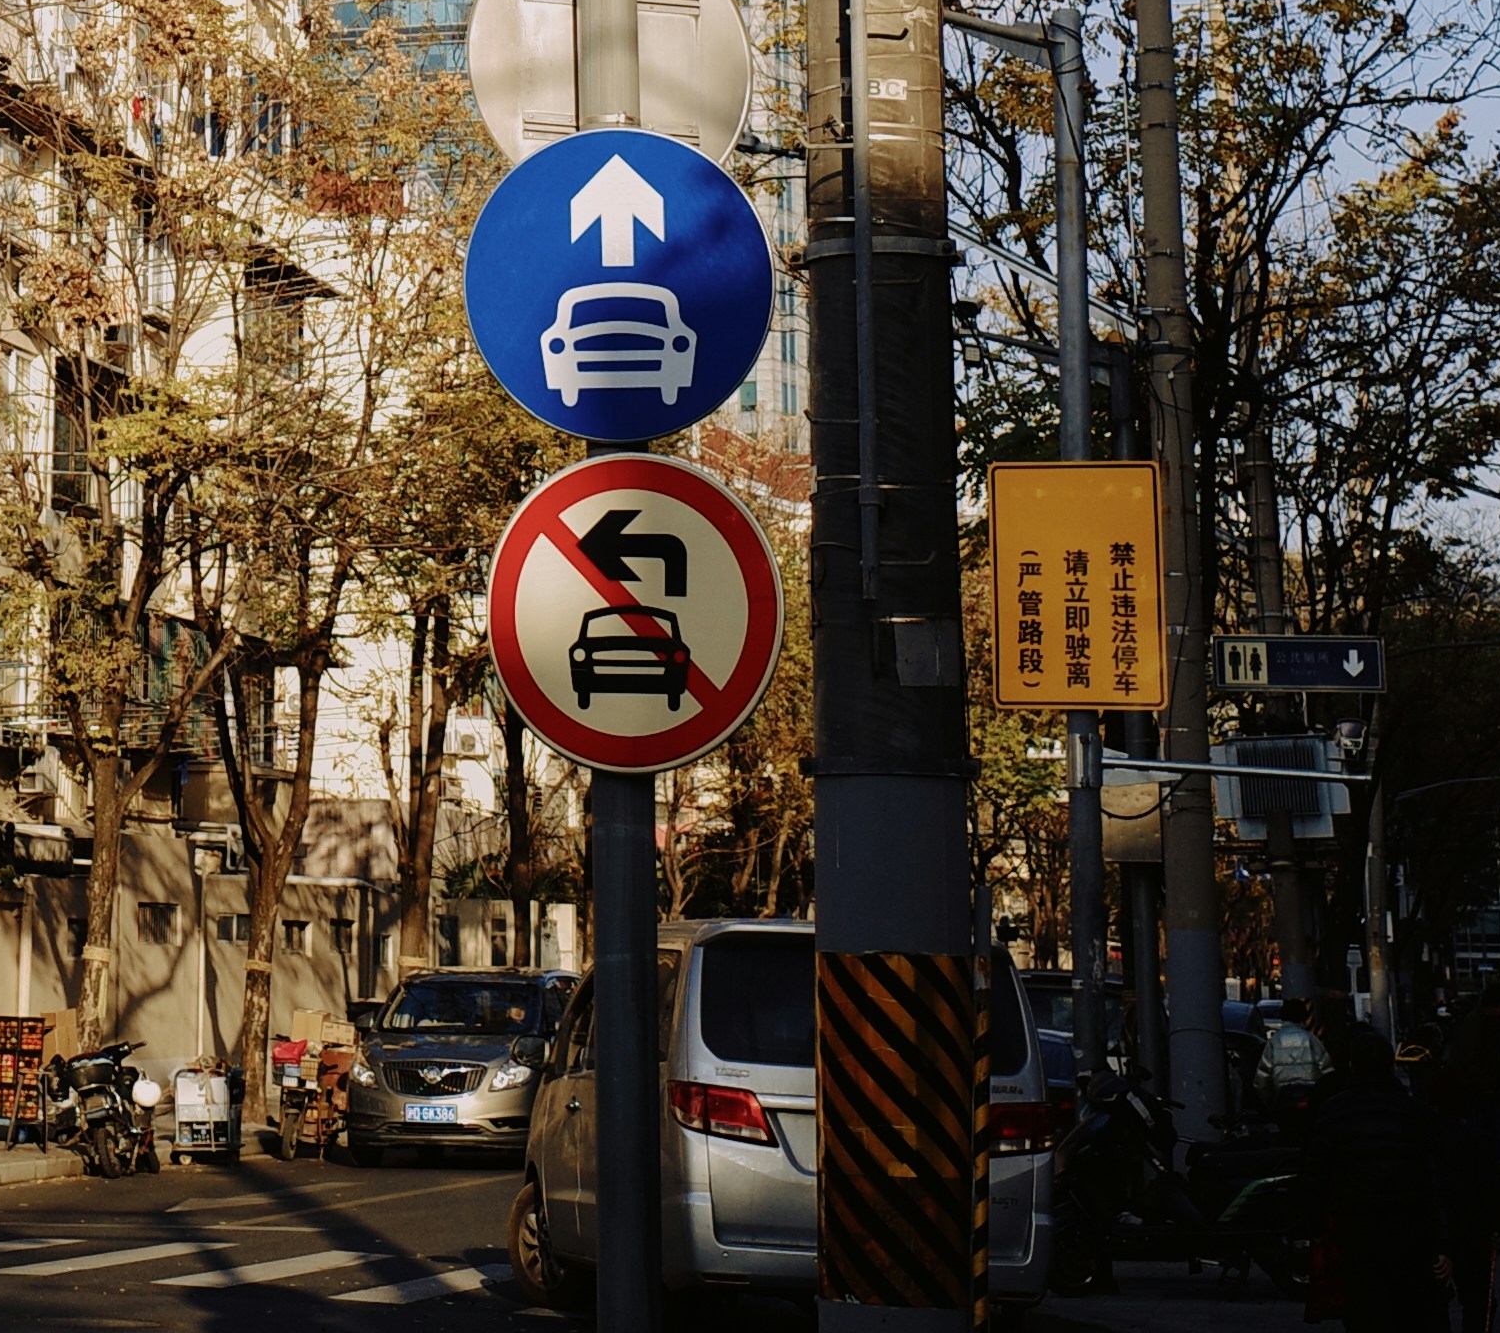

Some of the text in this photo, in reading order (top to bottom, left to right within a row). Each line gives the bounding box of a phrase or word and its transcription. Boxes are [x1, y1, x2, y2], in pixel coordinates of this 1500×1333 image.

[1063, 549, 1091, 689] 请立即驶离
[1109, 541, 1140, 697] 禁止违法停车
